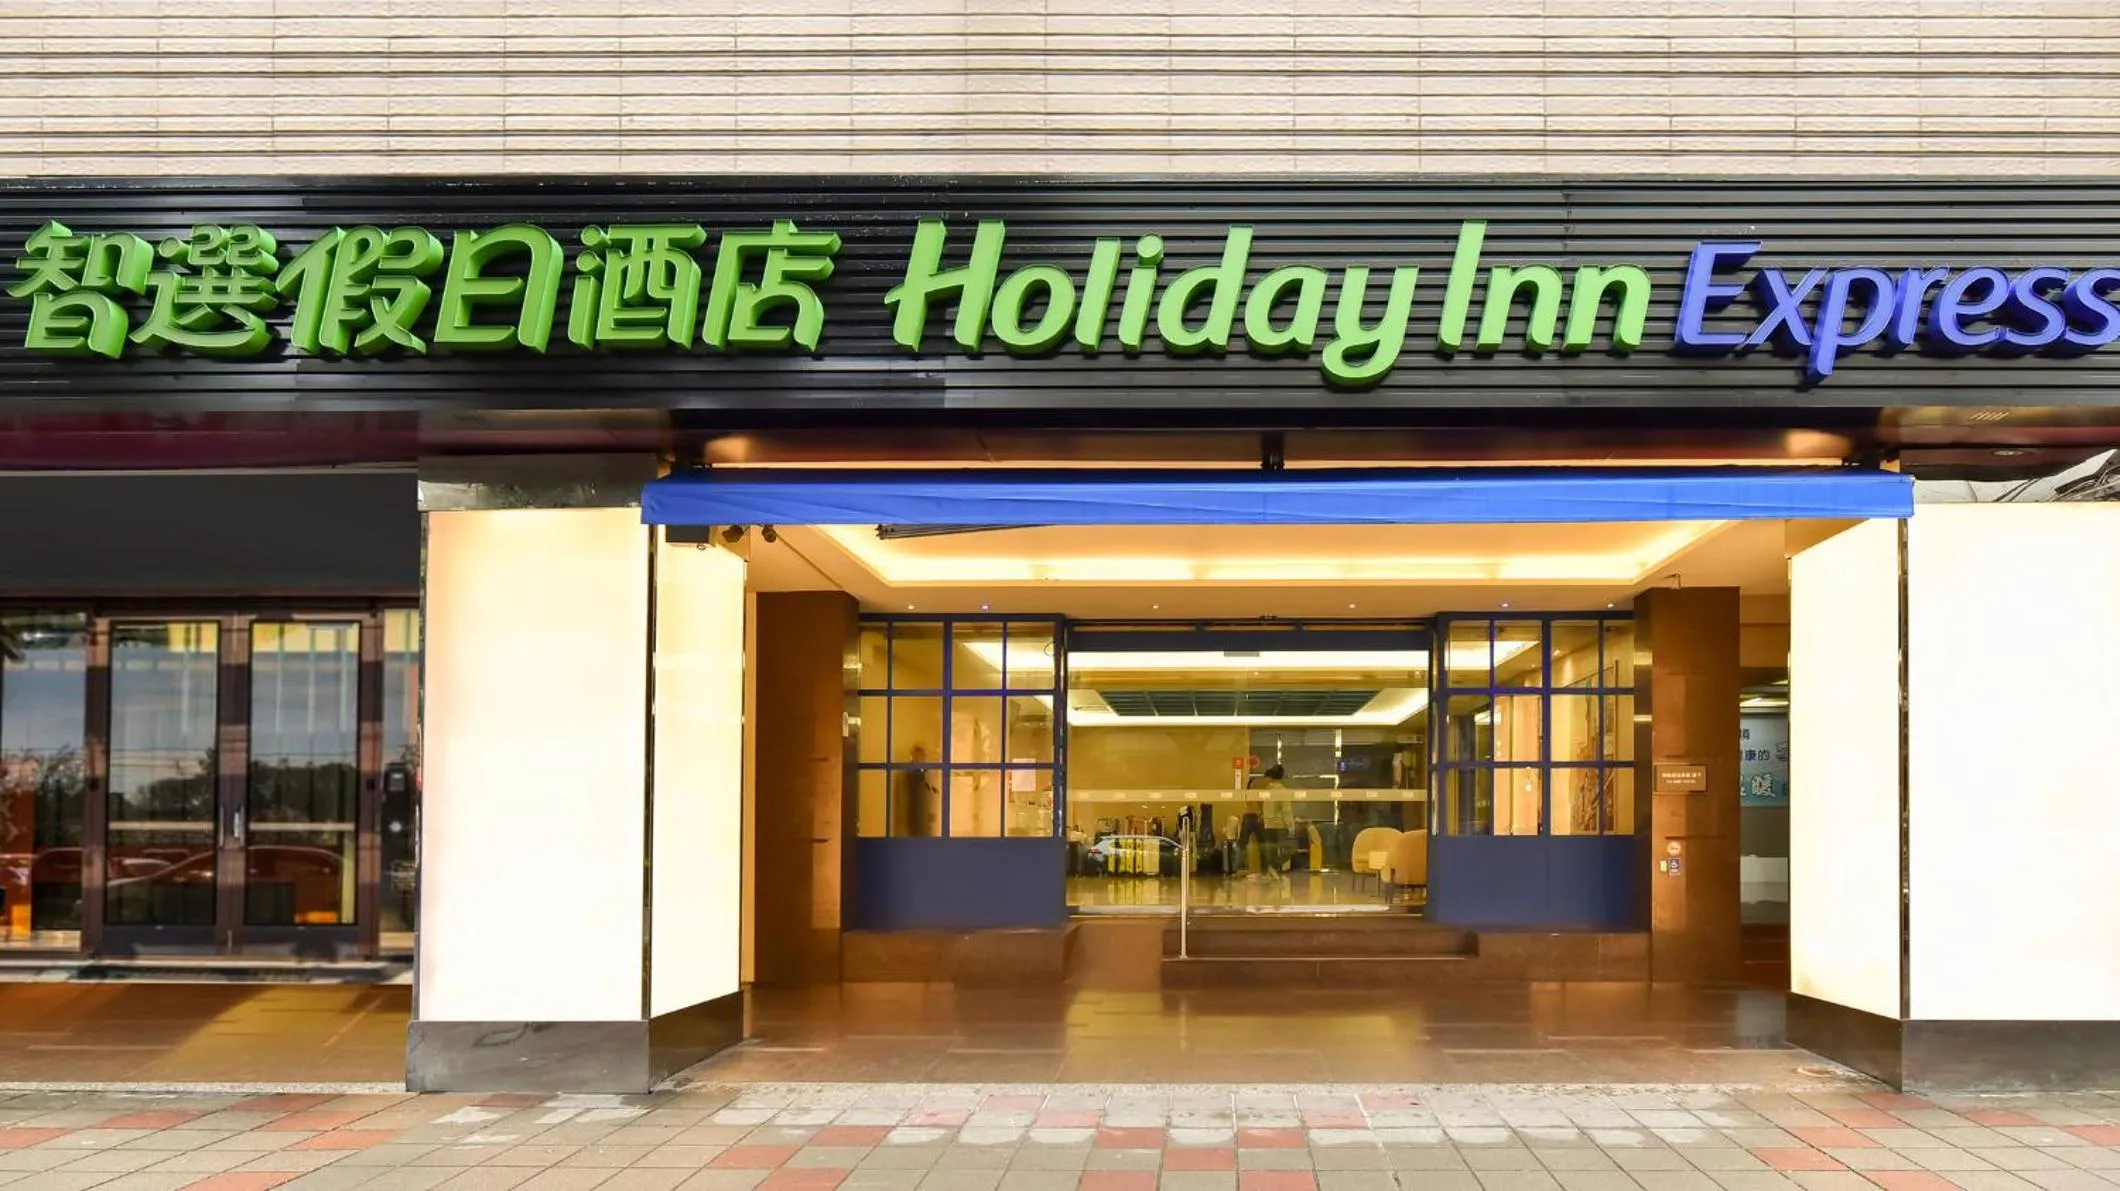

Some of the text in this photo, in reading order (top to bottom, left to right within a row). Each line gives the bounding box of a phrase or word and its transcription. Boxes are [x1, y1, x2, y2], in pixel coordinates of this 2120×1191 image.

[7, 219, 844, 358] 智選假日酒店
[884, 218, 2120, 387] Holiday Inn Express
